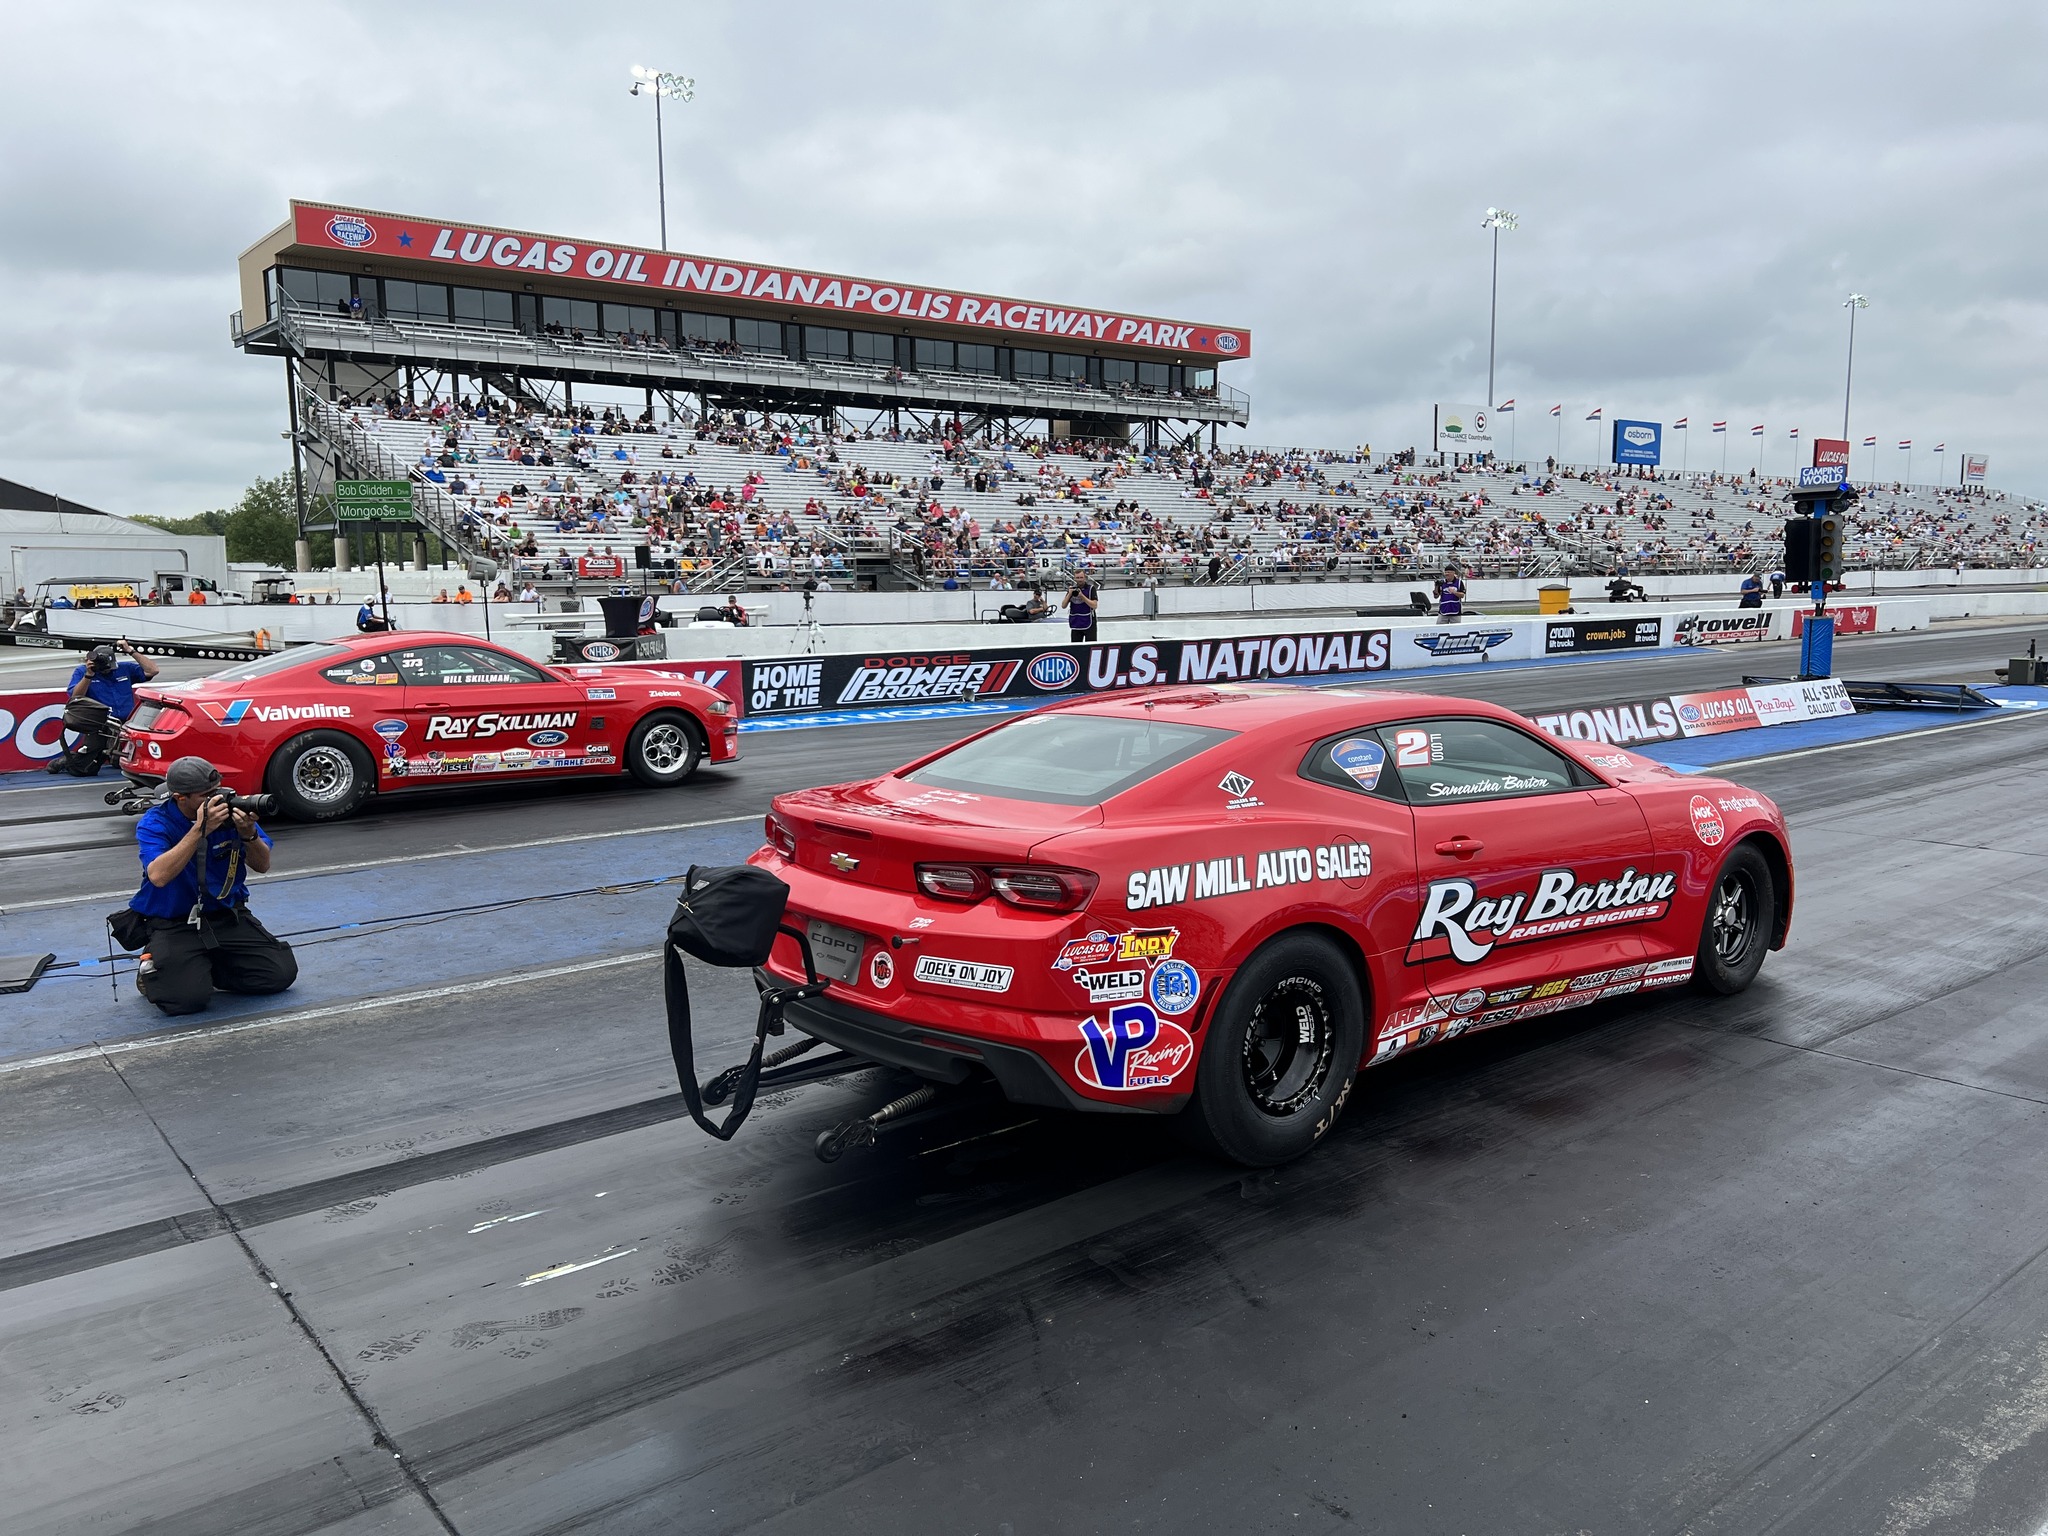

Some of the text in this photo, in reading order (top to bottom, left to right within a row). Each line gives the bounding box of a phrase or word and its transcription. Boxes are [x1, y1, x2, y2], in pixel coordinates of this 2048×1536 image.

[337, 230, 366, 241] RACEWAY
[429, 228, 1195, 350] LUCAS OIL INDIANAPOLIS RACEWAY PARK
[1217, 335, 1239, 350] NHRA
[1627, 429, 1653, 440] osborn
[1818, 450, 1841, 463] LUCAS
[1802, 465, 1844, 477] CAMPING
[1802, 473, 1843, 486] WORLD
[338, 484, 357, 496] Bob
[358, 483, 393, 496] Glidden
[340, 504, 396, 519] Mongoo$e
[764, 557, 774, 569] A
[1042, 557, 1050, 568] B
[1257, 556, 1264, 566] C
[1434, 631, 1490, 653] Indy
[1586, 628, 1627, 641] crown.jobs
[1641, 633, 1657, 642] trucks
[1704, 630, 1766, 640] BELLHOUSING
[1556, 639, 1575, 648] trucks
[588, 645, 614, 658] NHRA
[402, 658, 423, 668] 373
[864, 655, 971, 669] DODGE
[1087, 632, 1389, 691] U.S. NATIONALS
[752, 663, 823, 690] HOME
[861, 664, 991, 688] POWER
[1035, 656, 1074, 683] NHRA
[443, 674, 510, 684] BILL SKILLMAN
[751, 686, 821, 710] OF THE
[858, 681, 982, 701] BROKERS
[1802, 684, 1848, 702] ALL STAR
[252, 703, 351, 722] Valvoline
[1700, 697, 1754, 720] LUCAS OIL
[1755, 697, 1796, 713] Pep Boys
[1807, 702, 1836, 715] CALLOUT
[425, 712, 577, 741] RAY SKILLMAN
[1684, 722, 1706, 730] DRAG
[1706, 718, 1733, 727] RACING
[537, 733, 559, 744] Ford
[385, 743, 400, 758] VP
[532, 750, 564, 759] ARP
[586, 744, 609, 753] Coan
[1395, 730, 1430, 768] 2
[1429, 733, 1444, 761] FSS
[554, 758, 584, 767] MAHLE
[1347, 755, 1373, 764] constant
[442, 763, 472, 772] JESEL
[1348, 767, 1366, 775] FACTORY
[1426, 775, 1550, 797] Samantha Barton
[1693, 805, 1715, 820] NGK
[1699, 822, 1717, 831] SPARK
[1701, 829, 1720, 837] PLUGS
[1126, 842, 1372, 912] SAW MILL AUTO SALES
[1413, 866, 1677, 963] Ray Barton
[1508, 904, 1660, 941] RACING ENGINES
[811, 932, 858, 954] COPO
[1064, 942, 1110, 957] LUCAS OIL
[1120, 935, 1175, 958] INDY
[1661, 958, 1693, 968] PERFORMANCE
[920, 960, 1007, 984] JOEL'S ON JOY
[1089, 971, 1143, 991] WELD
[1277, 976, 1322, 993] RACING
[1643, 973, 1691, 988] MAGNUSON
[1091, 989, 1143, 1002] RACING
[1532, 979, 1570, 999] JEGS
[1498, 992, 1522, 1003] M/T
[1296, 1005, 1310, 1044] WELD
[1382, 1005, 1424, 1034] ARP
[1473, 1009, 1517, 1025] JESEL
[1081, 1004, 1159, 1088] VP
[1129, 1042, 1192, 1077] Racing
[1129, 1075, 1170, 1086] FUELS
